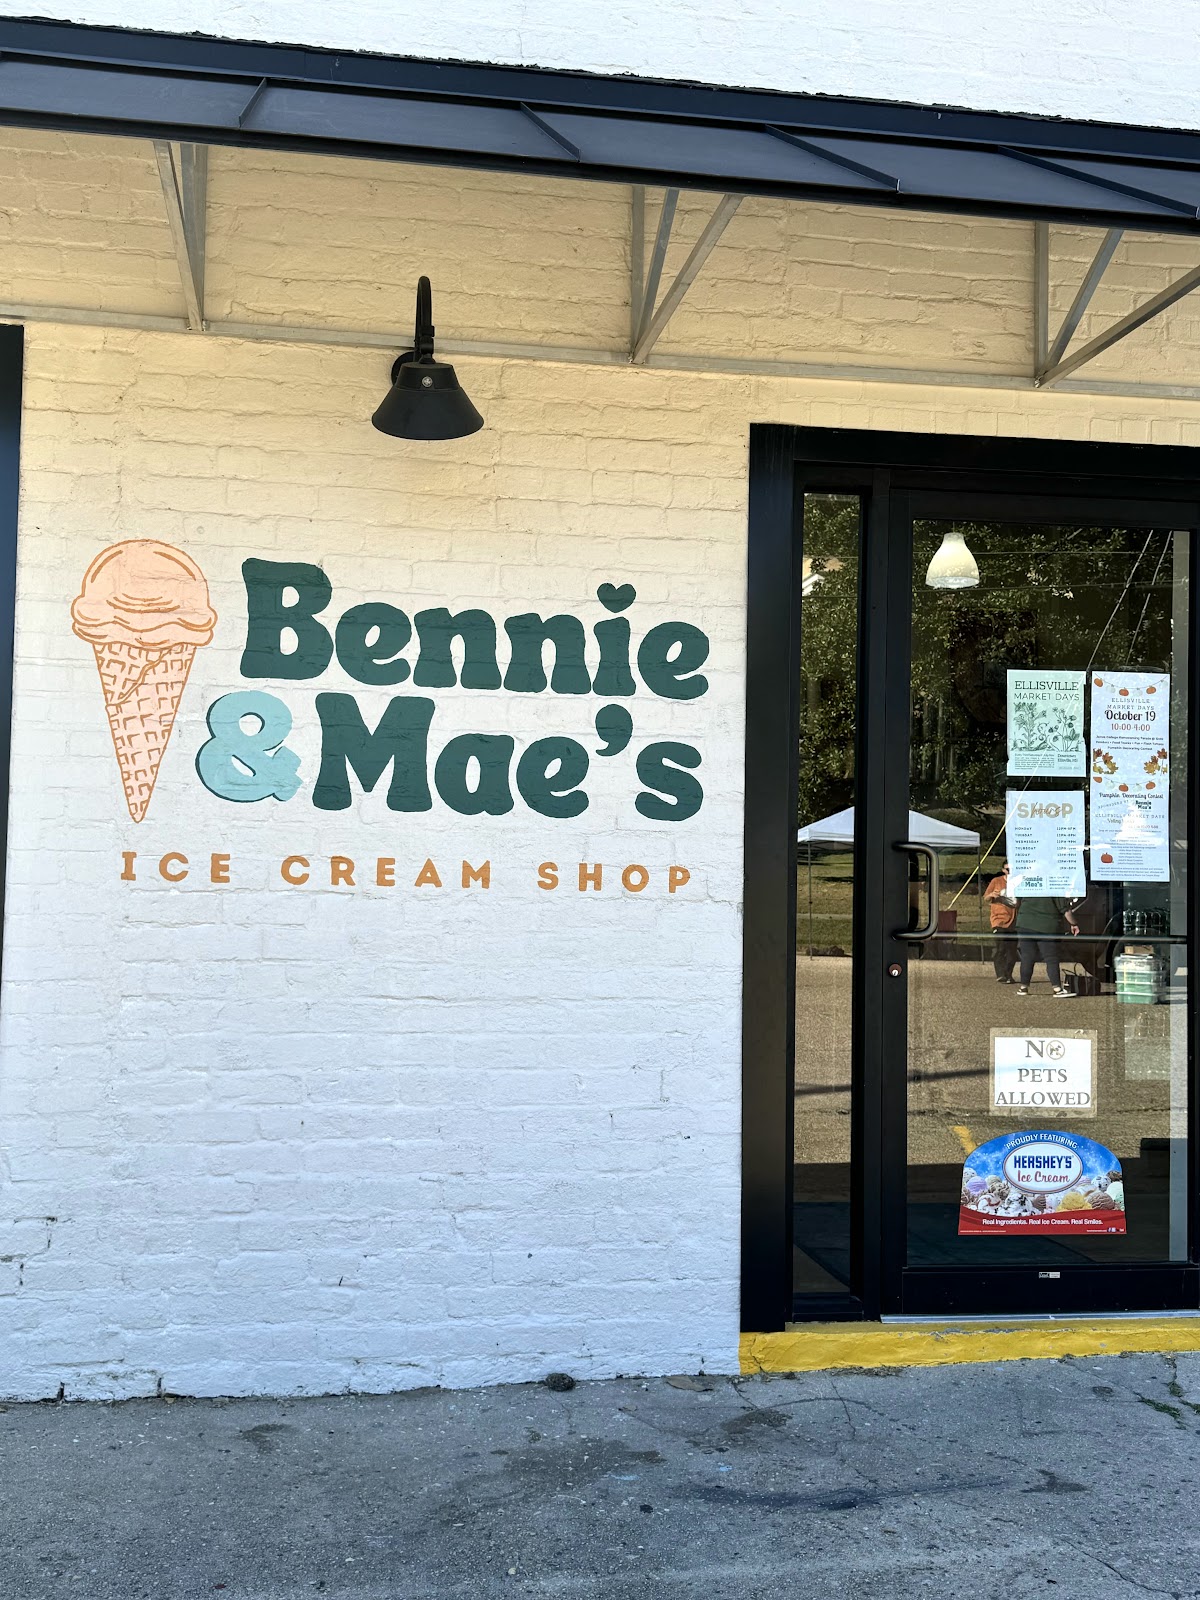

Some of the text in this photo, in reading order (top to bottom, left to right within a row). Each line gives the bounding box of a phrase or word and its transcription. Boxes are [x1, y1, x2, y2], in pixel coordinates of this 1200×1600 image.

[240, 558, 710, 700] Bennie
[1014, 680, 1079, 691] ELLISVILLE
[1013, 692, 1080, 701] MARKET DAYS
[1104, 709, 1156, 722] October 19
[195, 690, 704, 822] & Mae's
[1017, 802, 1074, 819] SHOP
[120, 850, 691, 894] ICE CREAM SHOP
[1017, 1068, 1068, 1084] PETS
[995, 1091, 1091, 1106] ALLOWED
[1006, 1133, 1078, 1150] PROUDLY FEATURING
[1013, 1155, 1072, 1169] HERSHEY'S
[1017, 1170, 1071, 1183] Ice Cream
